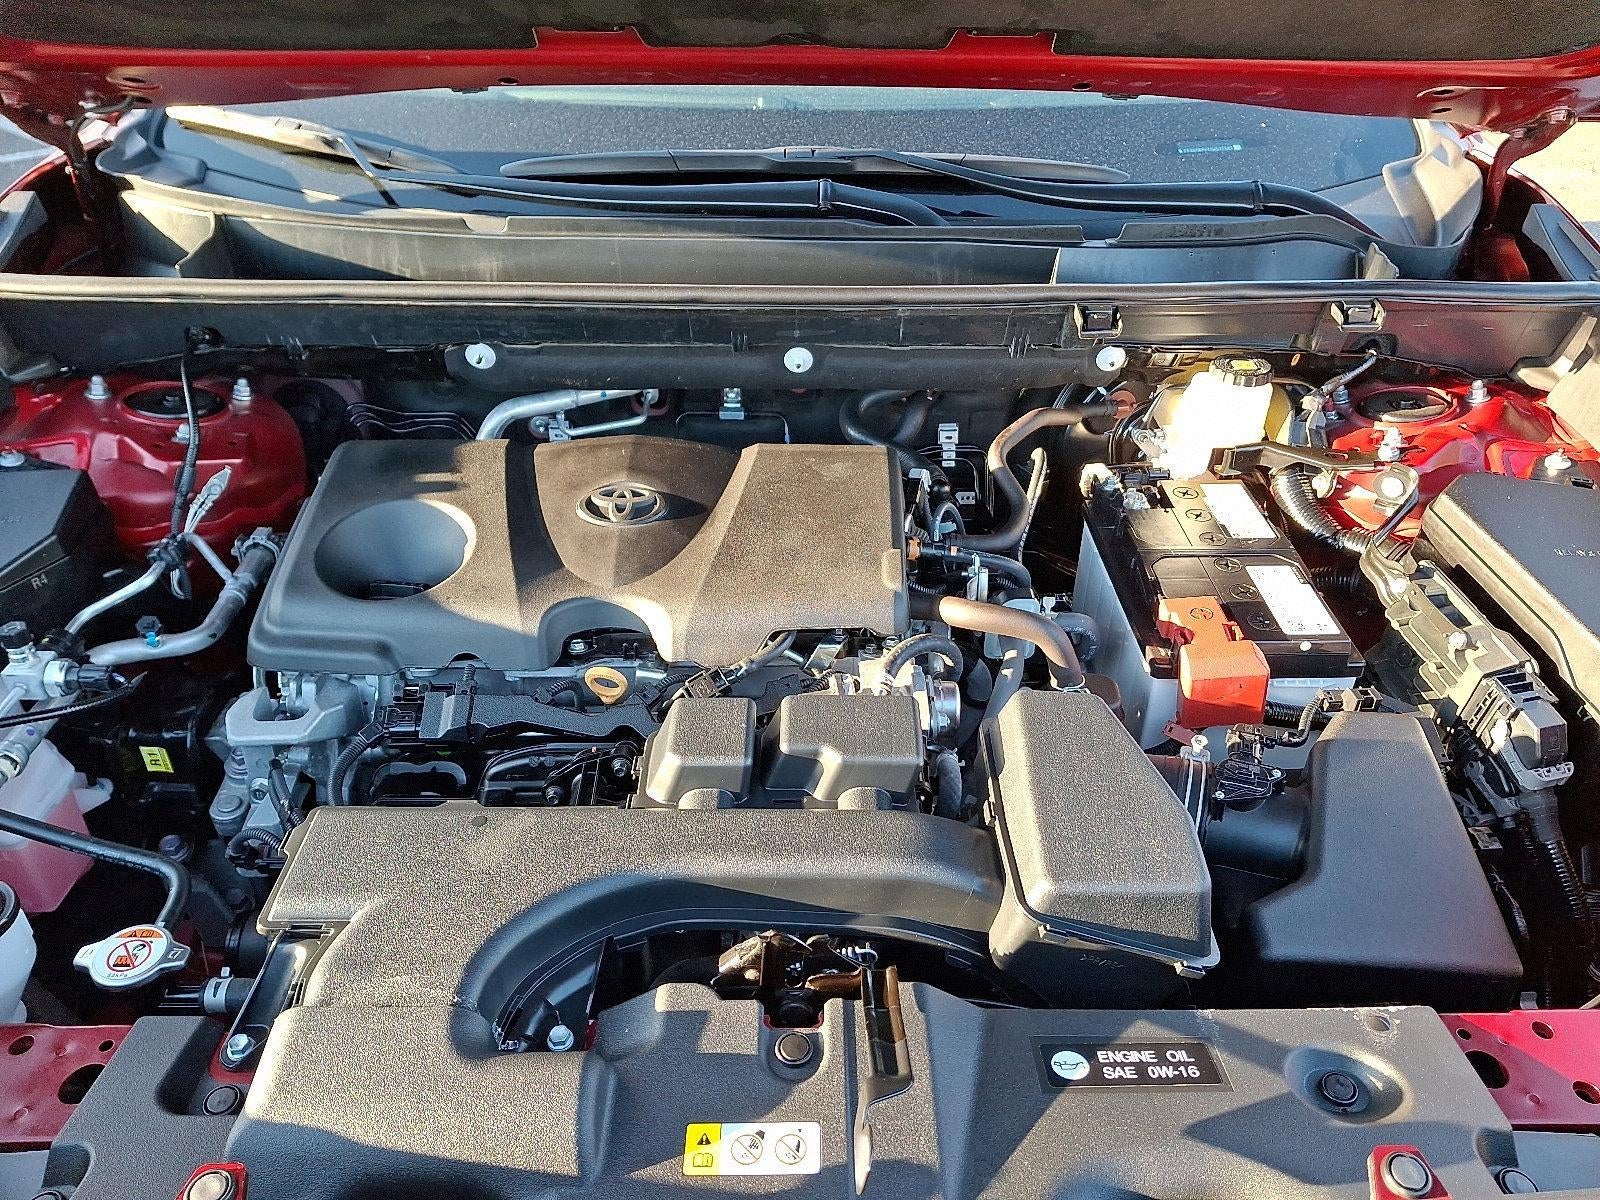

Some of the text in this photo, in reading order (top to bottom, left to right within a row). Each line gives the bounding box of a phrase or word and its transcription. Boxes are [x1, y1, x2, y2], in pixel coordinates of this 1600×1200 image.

[31, 573, 49, 590] R4
[1096, 1049, 1195, 1063] ENGINE OIL
[1102, 1065, 1200, 1079] SAE 0W-16
